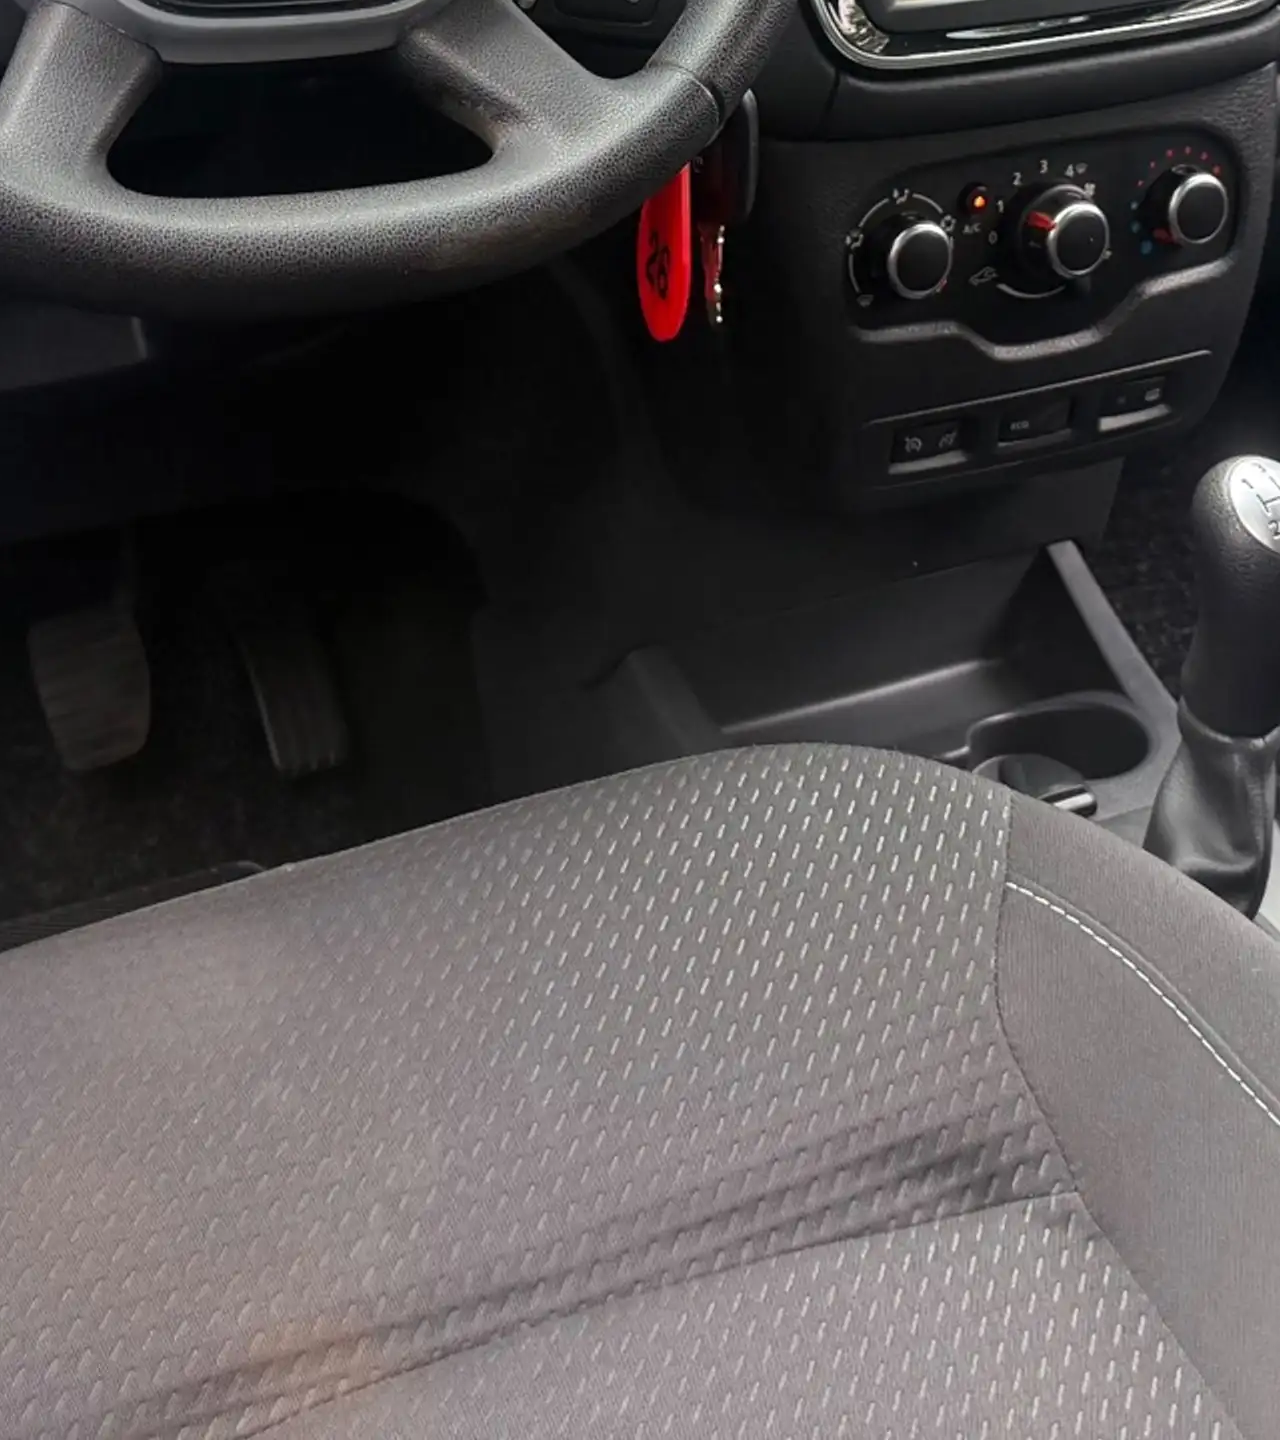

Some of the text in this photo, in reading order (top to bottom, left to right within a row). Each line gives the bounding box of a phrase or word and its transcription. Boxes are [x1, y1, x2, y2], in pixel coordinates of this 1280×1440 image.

[1040, 160, 1049, 174] 3
[1065, 164, 1074, 177] 4
[1013, 172, 1022, 186] 2
[996, 200, 1004, 213] 1
